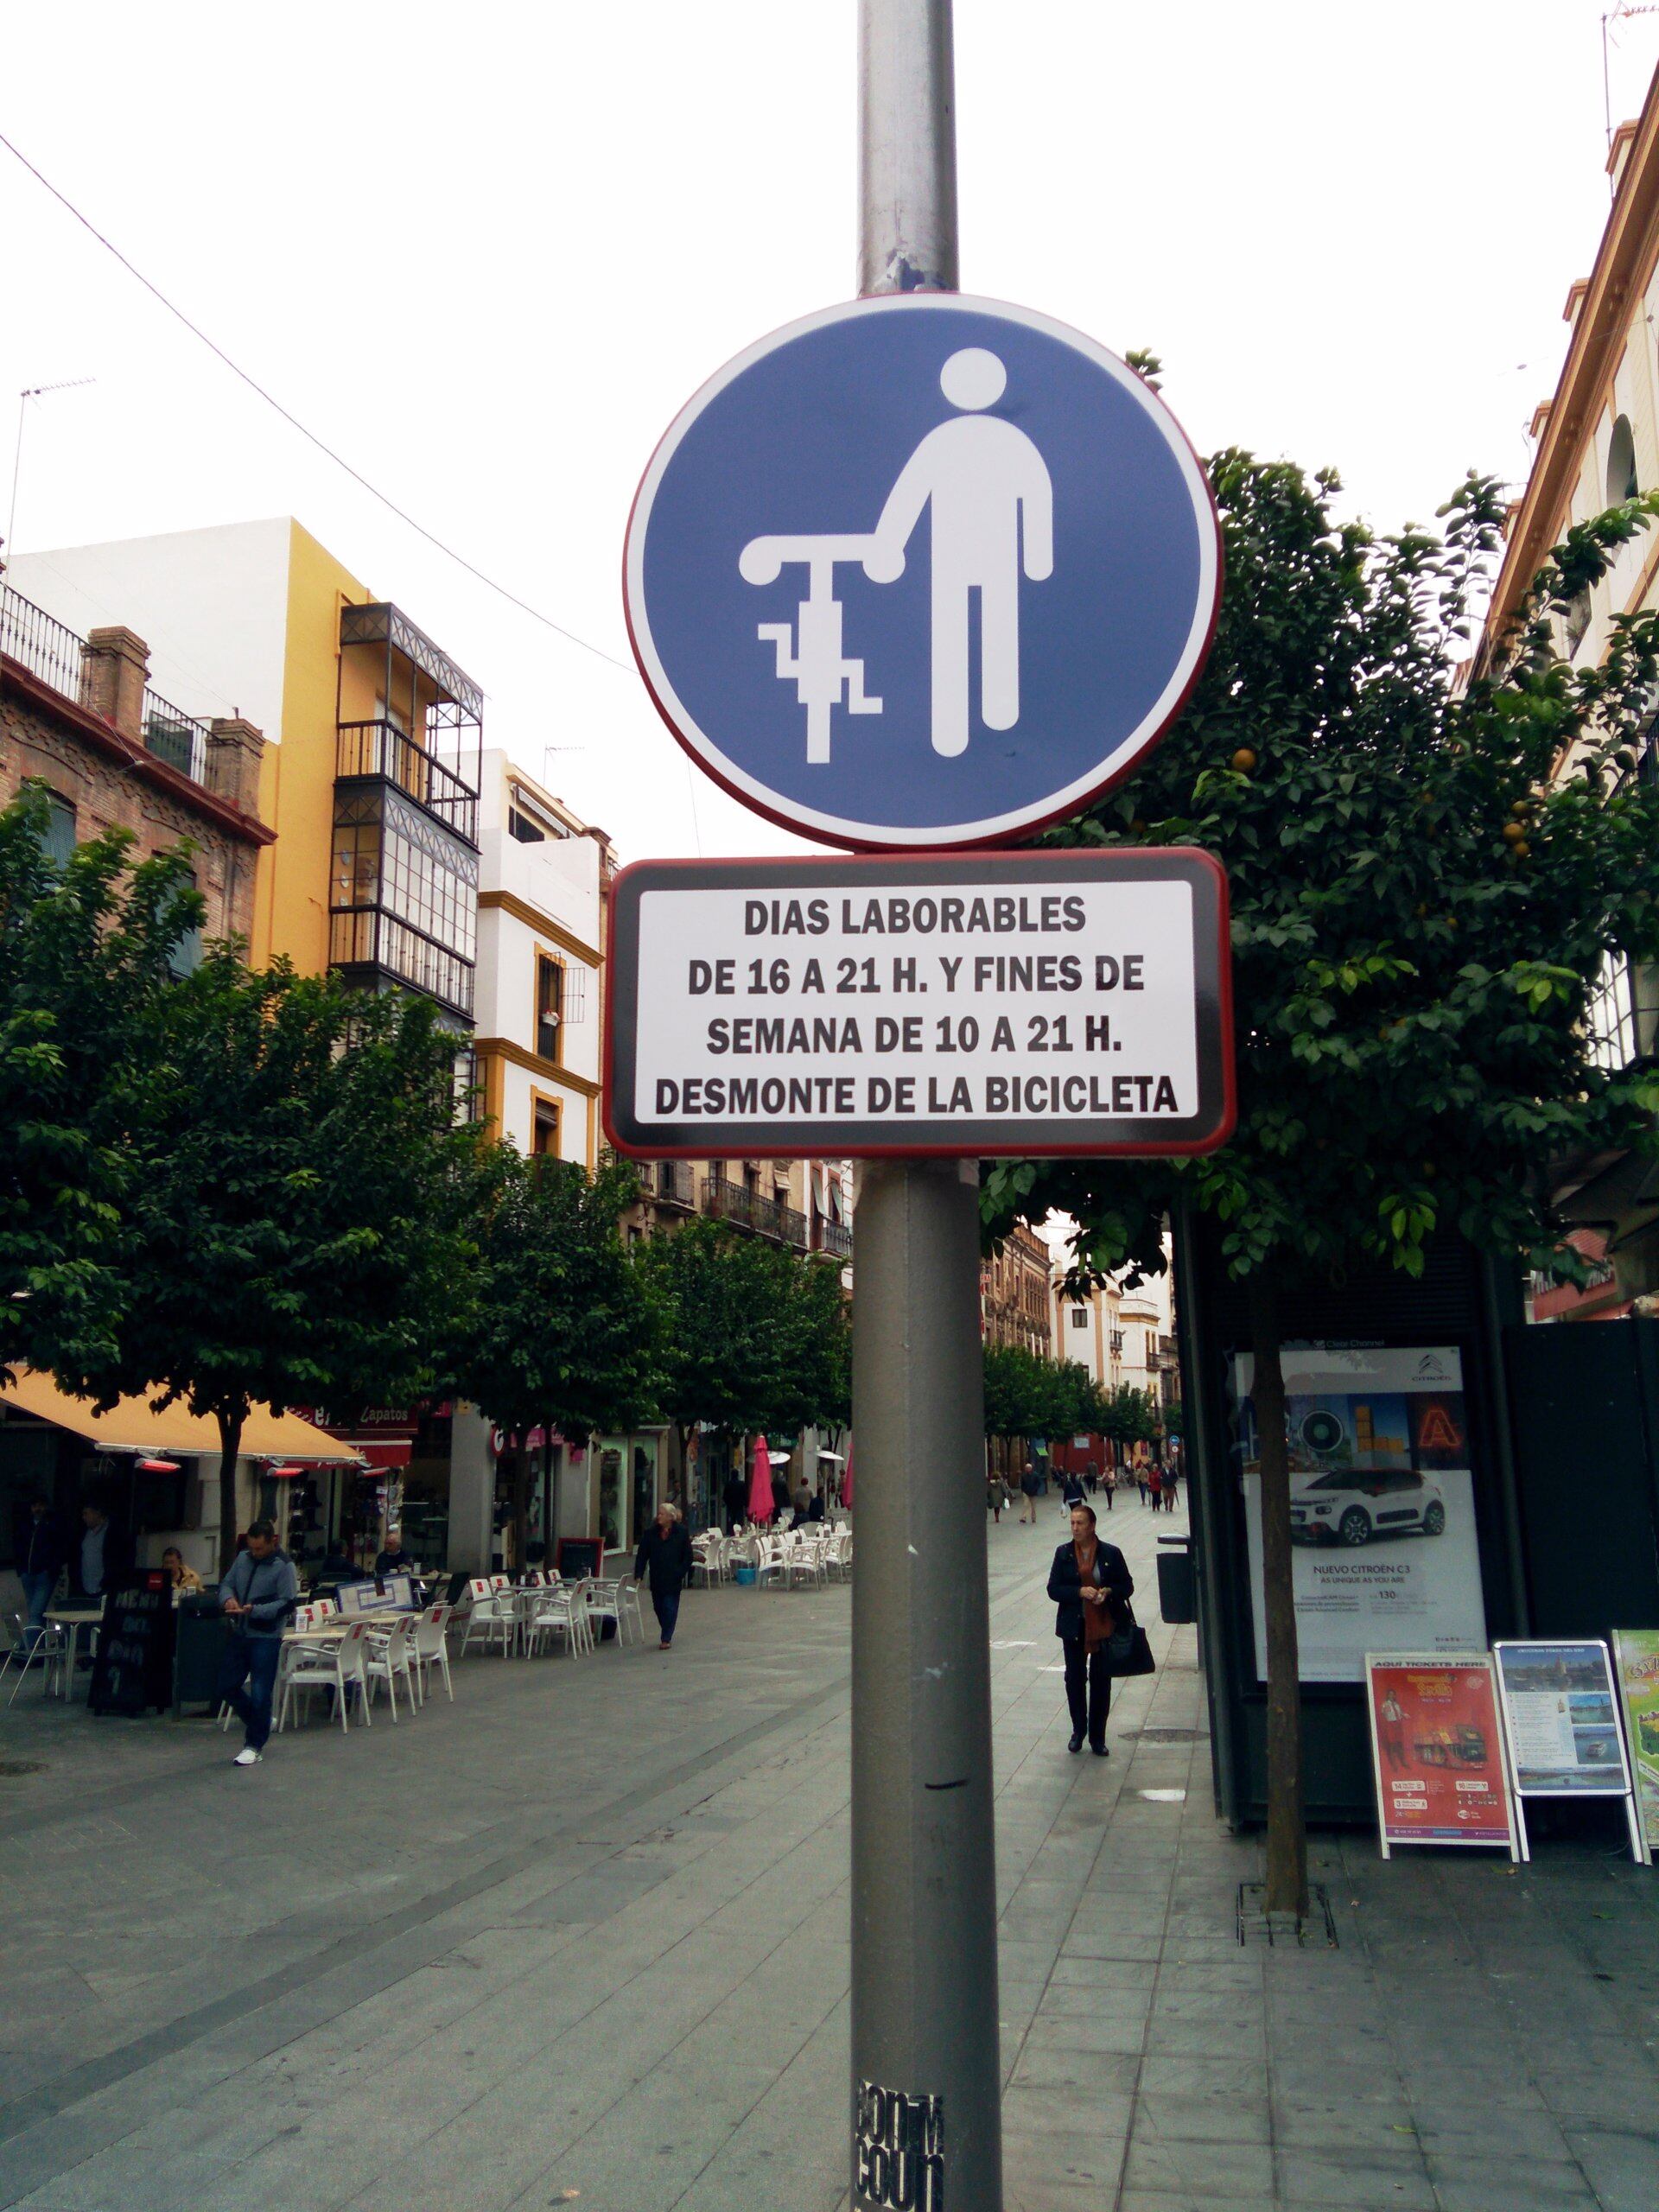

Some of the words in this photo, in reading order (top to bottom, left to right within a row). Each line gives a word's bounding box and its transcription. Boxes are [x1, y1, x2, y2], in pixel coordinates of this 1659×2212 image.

[746, 899, 829, 935] DIAS
[842, 897, 1086, 934] LABORABLES
[690, 960, 735, 995] DE
[748, 959, 790, 995] 16
[802, 958, 824, 994] A
[837, 957, 880, 994] 21
[893, 957, 927, 993] H.
[939, 957, 963, 993] Y
[976, 956, 1083, 992] FINES
[1096, 955, 1144, 991] DE
[707, 1018, 862, 1054] SEMANA
[876, 1017, 923, 1052] DE
[936, 1016, 979, 1052] 10
[991, 1016, 1015, 1052] A
[1028, 1015, 1072, 1052] 21
[1086, 1015, 1121, 1052] H.
[656, 1077, 855, 1115] DESMONTE
[868, 1077, 916, 1114] DE
[929, 1077, 974, 1113] LA
[987, 1076, 1179, 1113] BICICLETA
[1313, 1565, 1349, 1574] NUEVO
[1378, 1591, 1396, 1599] 130
